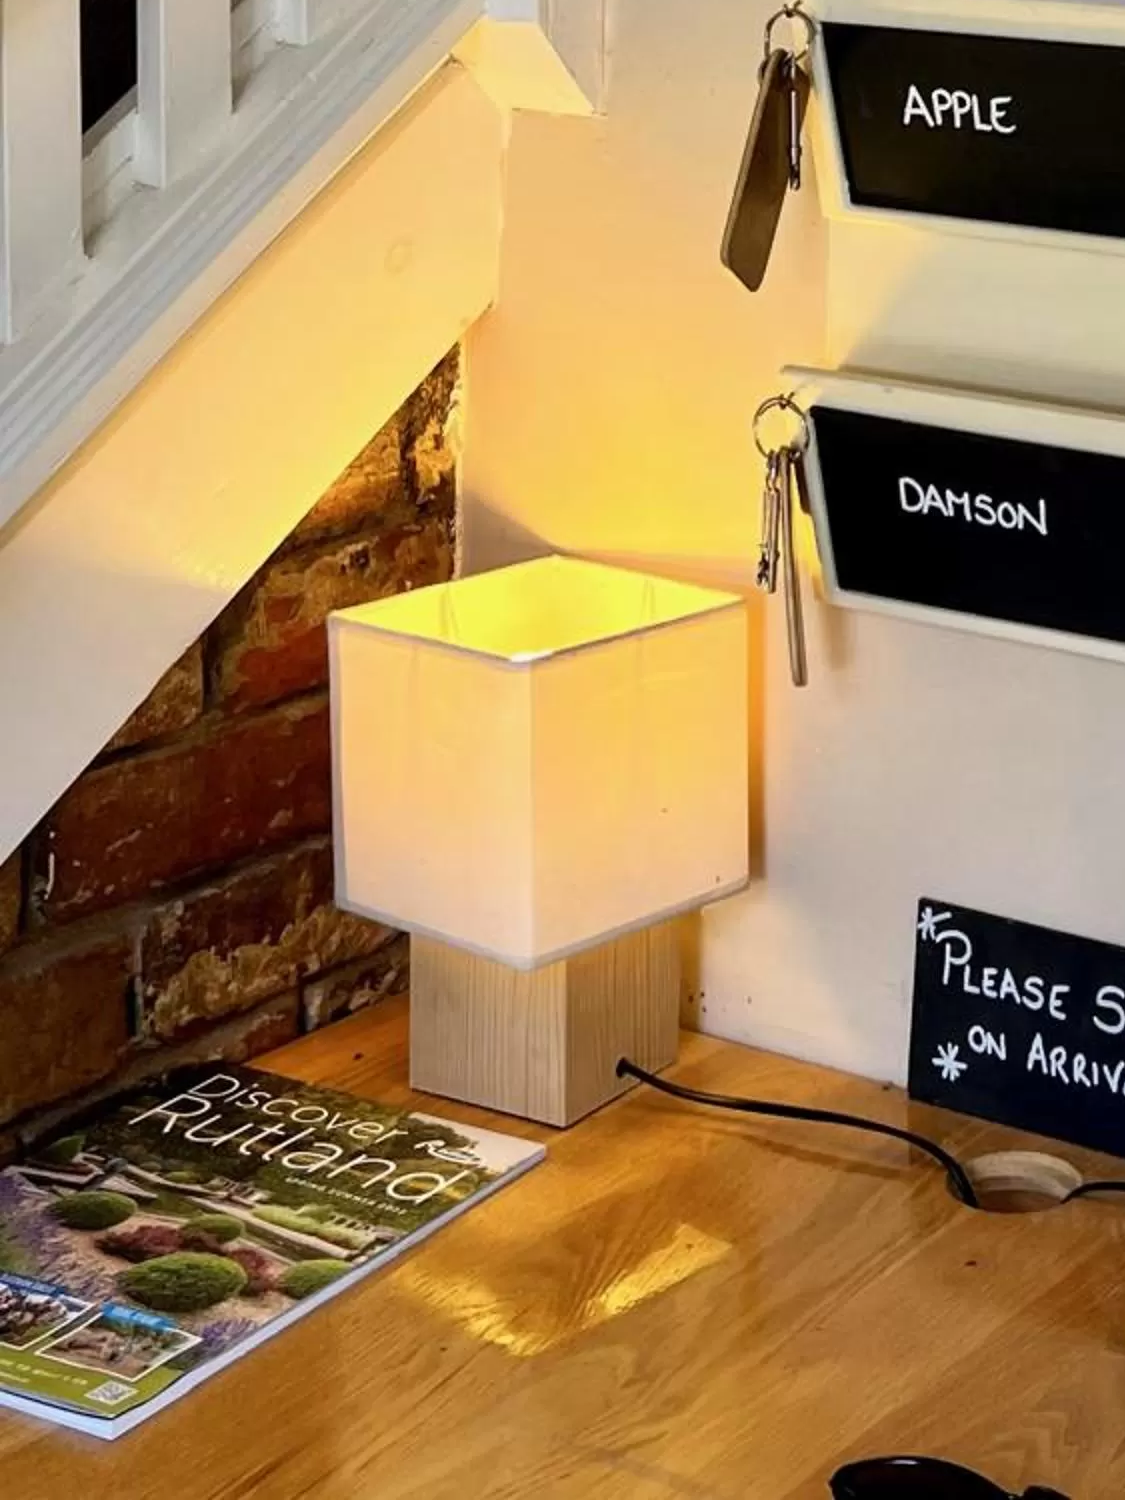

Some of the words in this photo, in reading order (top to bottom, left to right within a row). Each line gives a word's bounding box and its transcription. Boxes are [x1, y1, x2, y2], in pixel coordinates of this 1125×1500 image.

[903, 85, 1016, 133] APPLE
[899, 476, 1048, 535] DAMSON
[934, 929, 1071, 1021] PLEASE
[967, 1025, 1007, 1061] ON
[187, 1073, 409, 1144] Discover
[128, 1093, 475, 1206] Rutland
